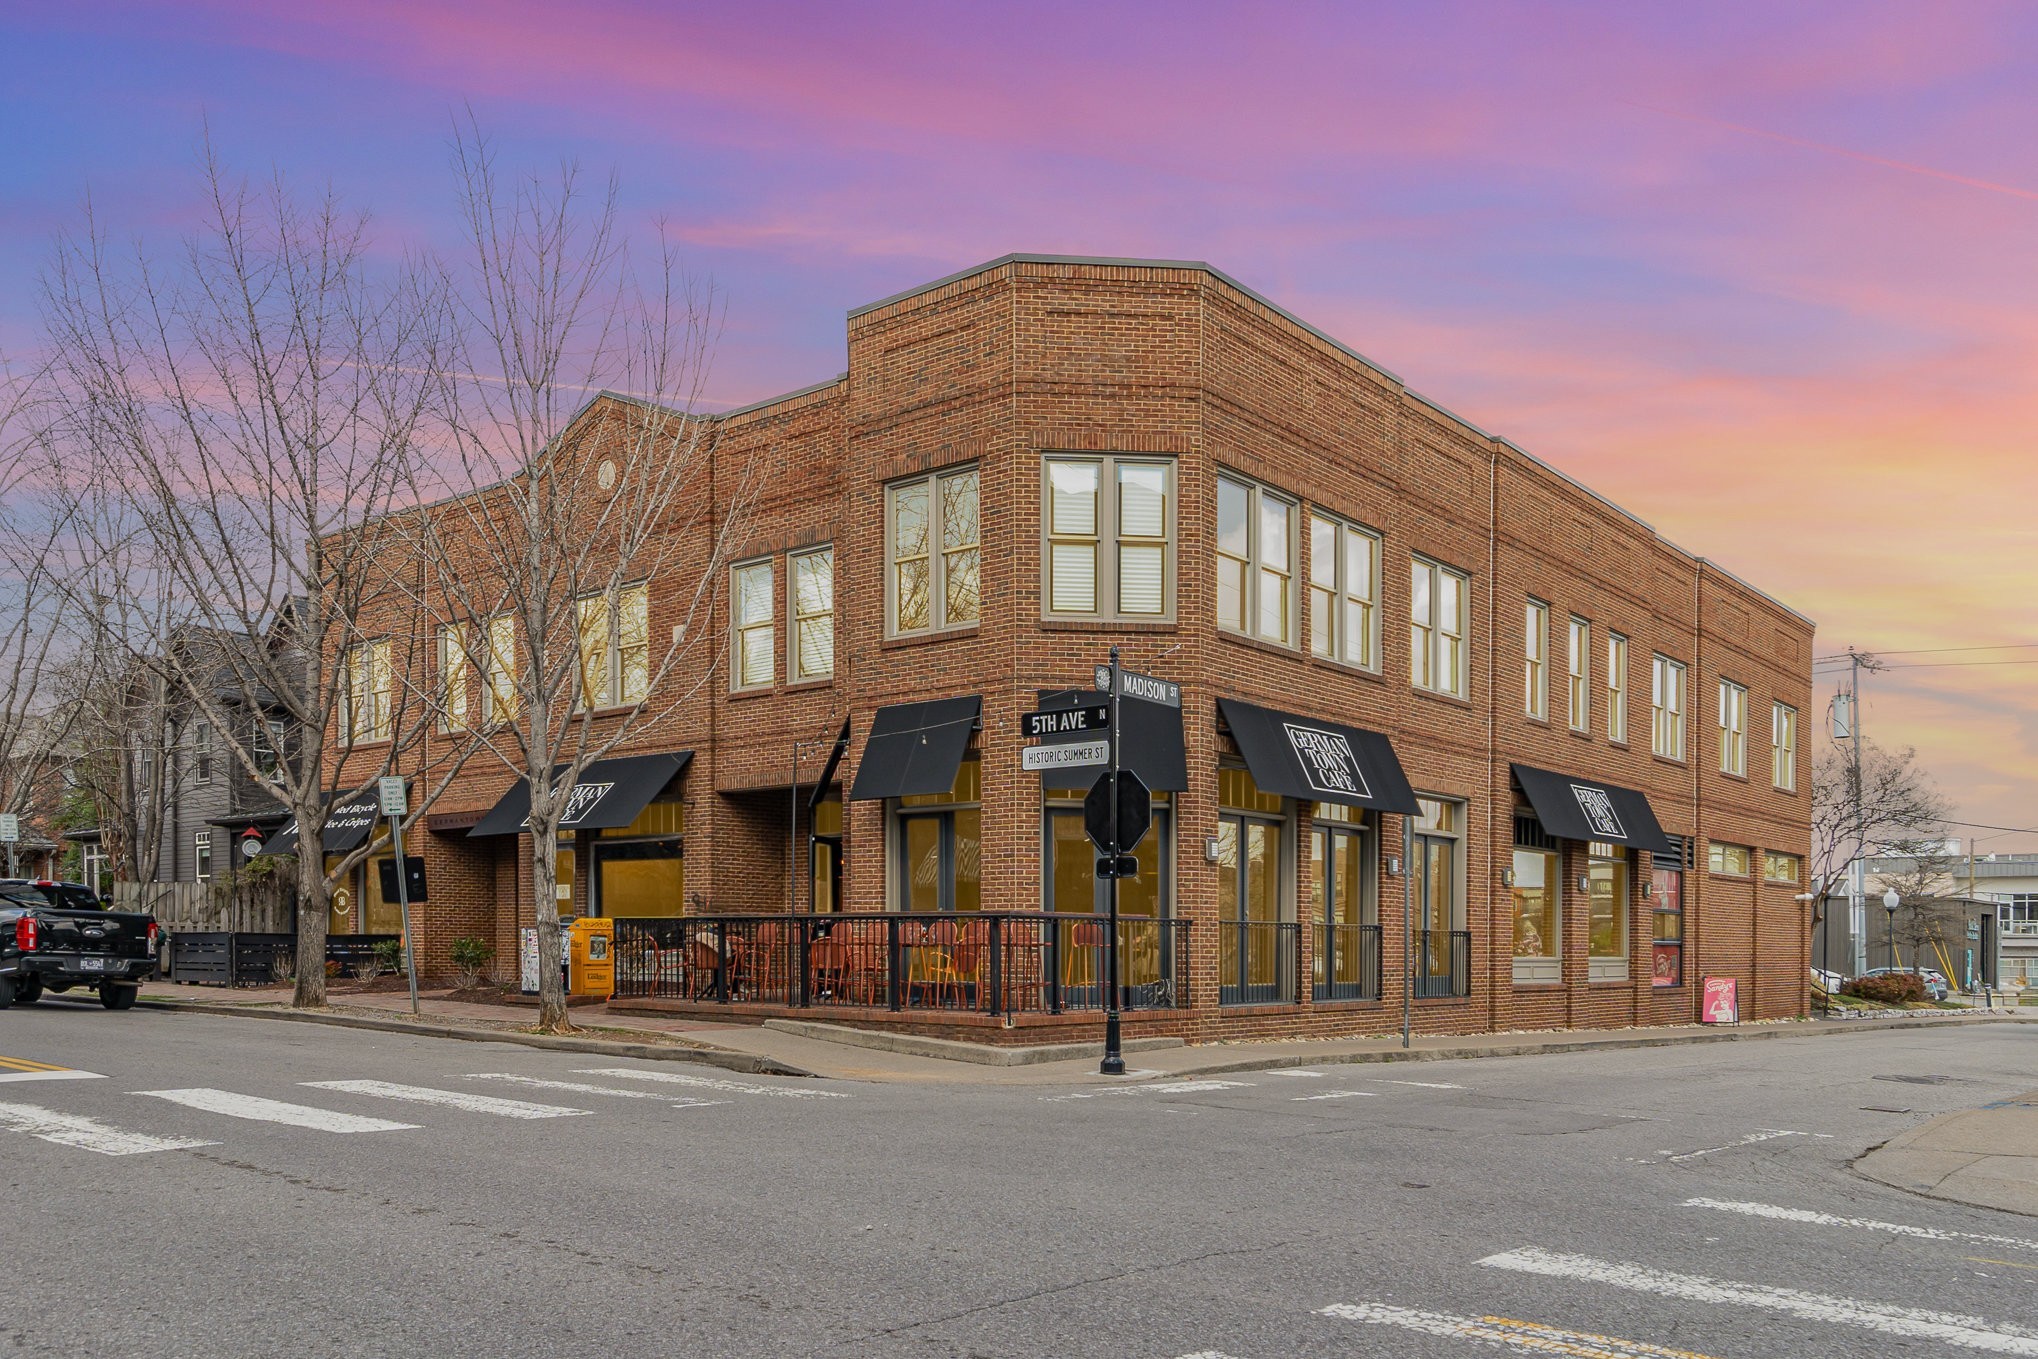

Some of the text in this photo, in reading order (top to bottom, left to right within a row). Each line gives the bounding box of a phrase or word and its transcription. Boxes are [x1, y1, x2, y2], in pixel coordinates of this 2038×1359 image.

[1123, 674, 1178, 701] MADISON ST
[1031, 708, 1106, 734] 5TH AVE N
[1028, 747, 1104, 764] HISTORIC SUMMER ST
[1290, 728, 1350, 757] GERMAN
[1304, 748, 1351, 774] TOWN
